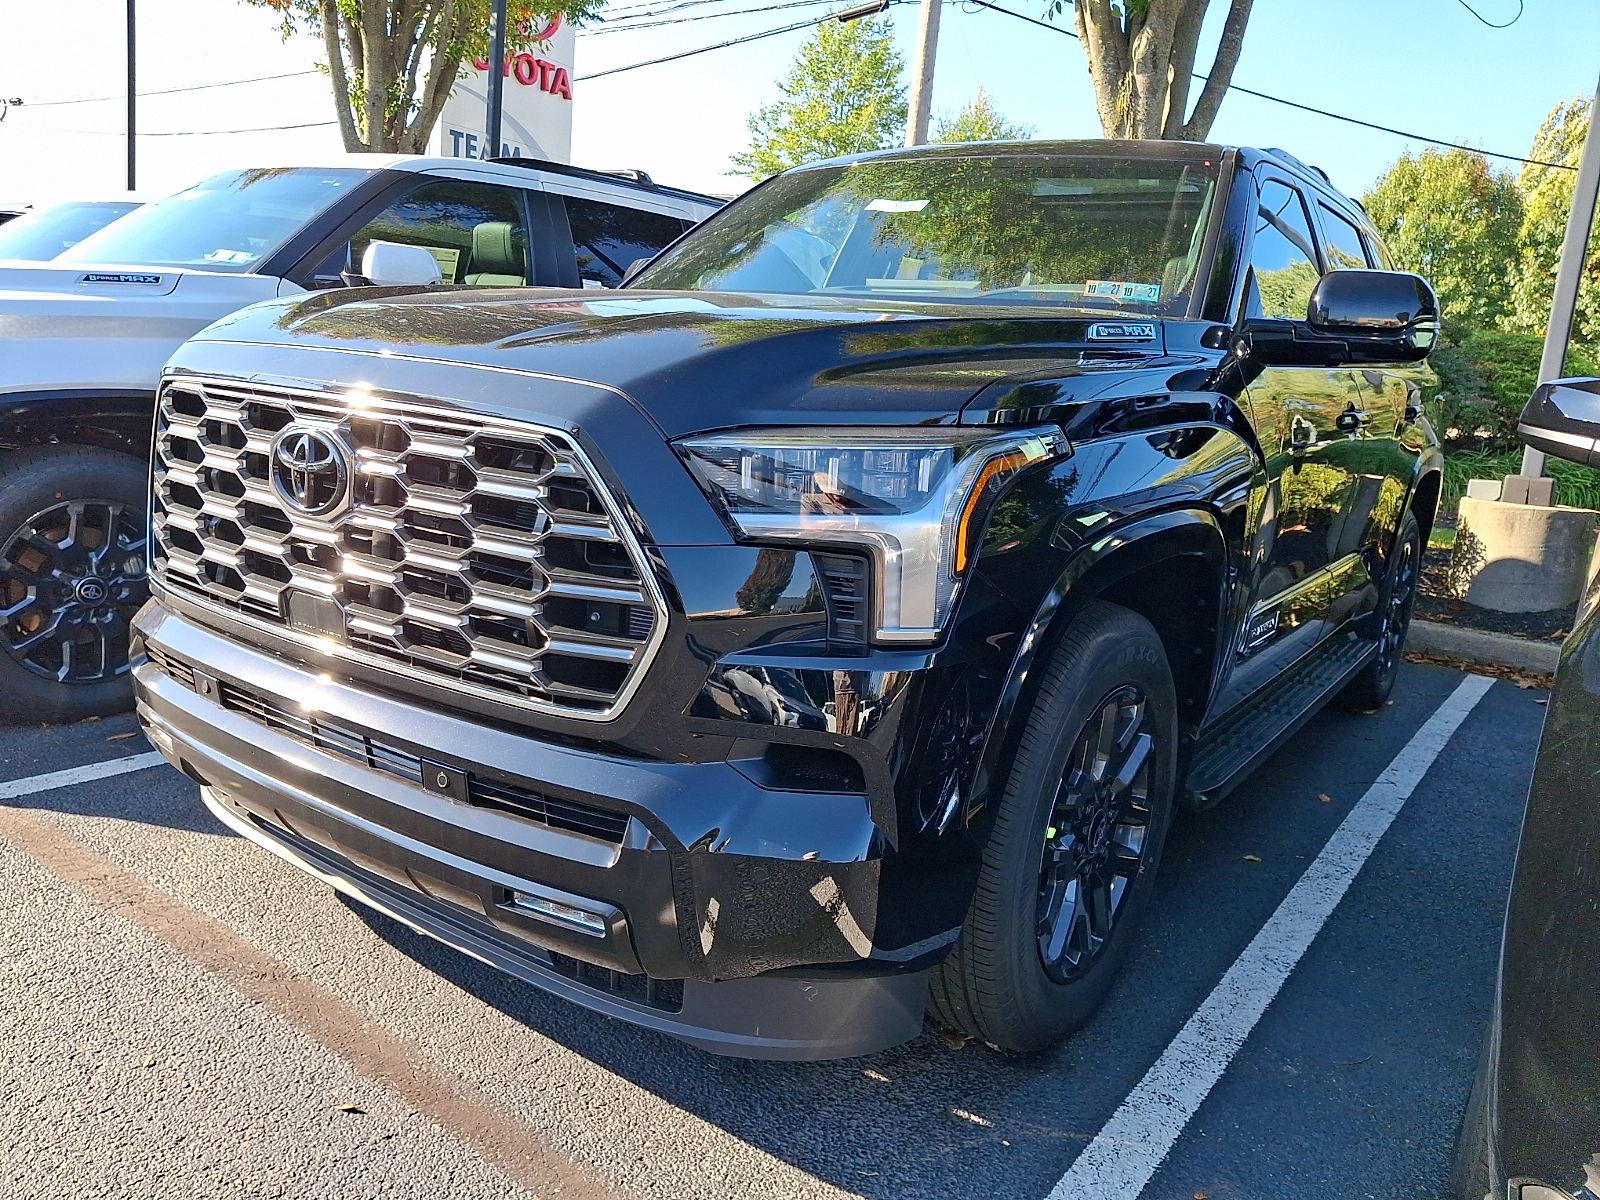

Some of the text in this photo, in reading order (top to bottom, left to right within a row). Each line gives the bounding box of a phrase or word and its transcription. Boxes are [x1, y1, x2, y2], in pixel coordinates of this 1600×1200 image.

[449, 129, 521, 160] TEM
[120, 275, 157, 283] MAX
[1110, 283, 1121, 296] 27
[1147, 287, 1157, 298] 27
